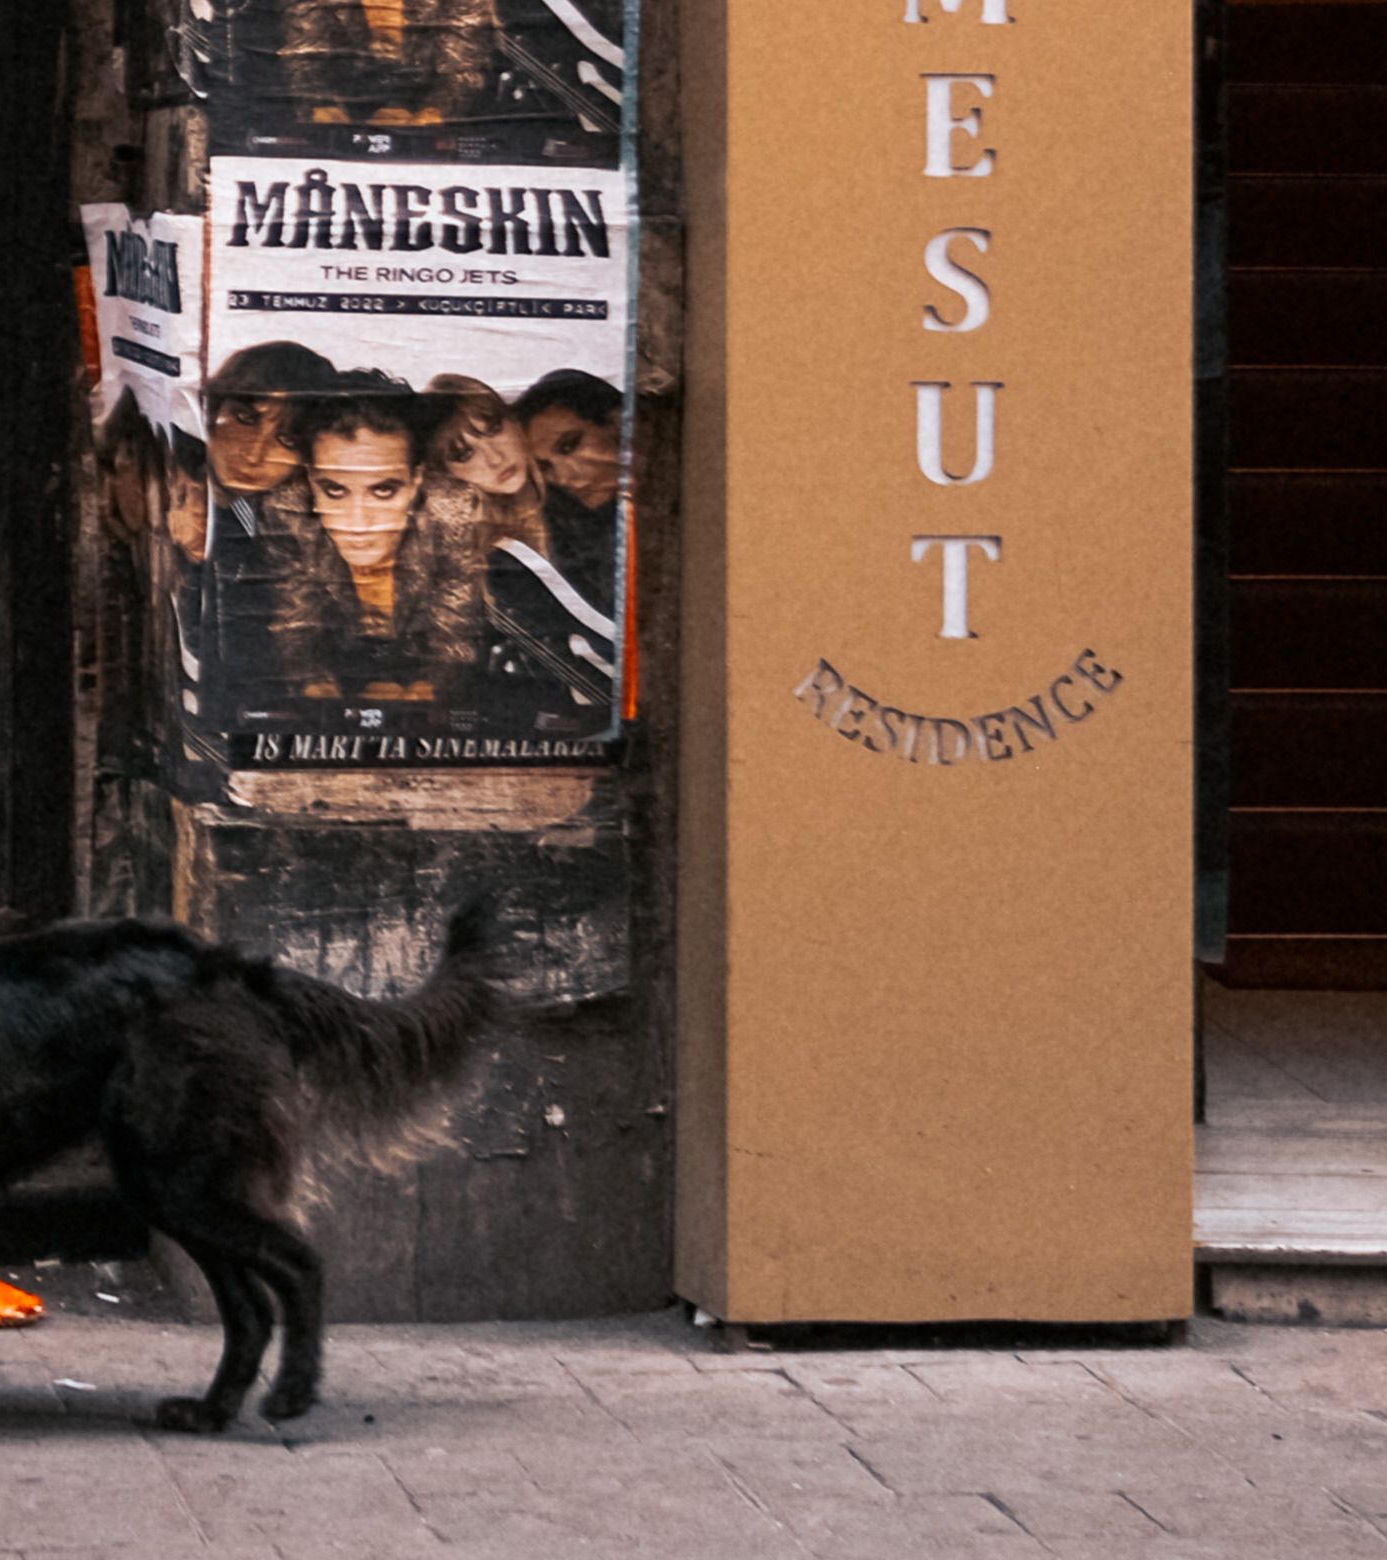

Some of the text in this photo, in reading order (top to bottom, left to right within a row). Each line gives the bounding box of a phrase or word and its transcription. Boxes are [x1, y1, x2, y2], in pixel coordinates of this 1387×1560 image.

[320, 265, 518, 284] THE RINGO JETS
[228, 293, 250, 307] 23
[263, 294, 327, 309] TEMMUZ
[341, 296, 384, 311] 2022
[563, 301, 606, 316] PARK
[792, 648, 1125, 766] RESIDENCE
